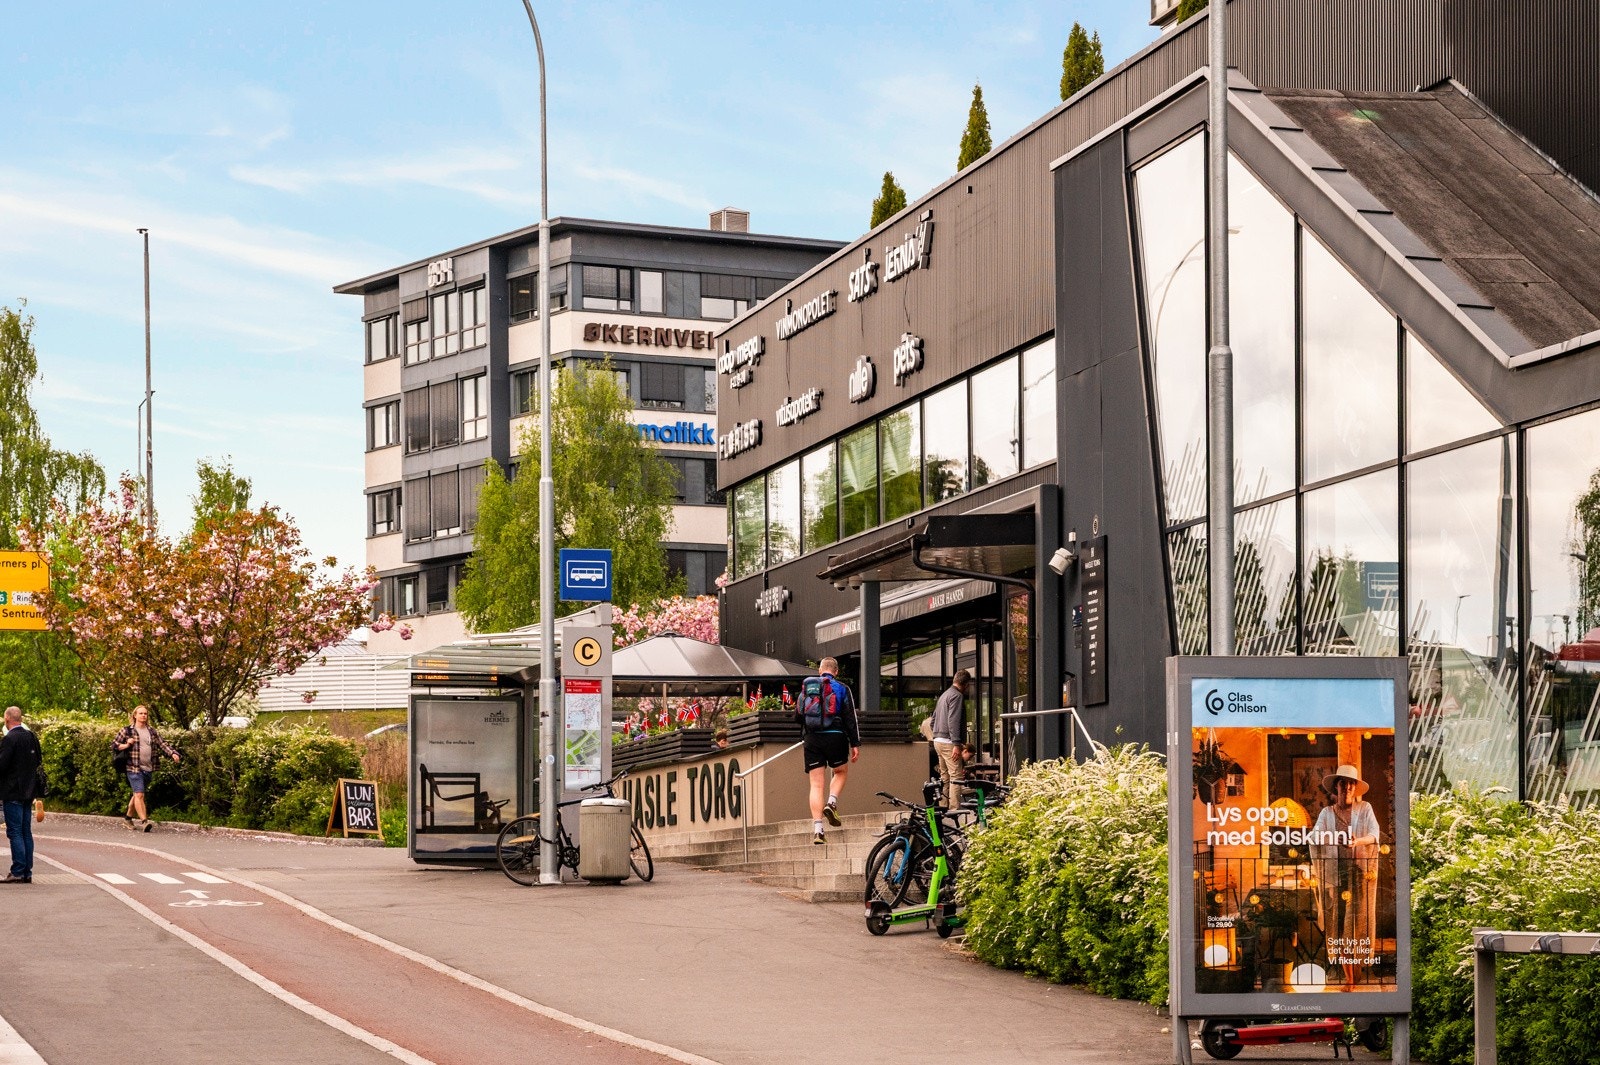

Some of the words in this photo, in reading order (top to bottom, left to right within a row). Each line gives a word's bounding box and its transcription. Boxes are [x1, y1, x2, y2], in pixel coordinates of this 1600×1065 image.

[848, 262, 873, 302] SATS
[776, 290, 834, 340] VINMONOPOLET
[584, 322, 714, 350] ØKERNVEI
[627, 421, 715, 446] matikk
[31, 560, 43, 570] pl.
[581, 643, 594, 660] C
[1228, 692, 1253, 702] Clas
[1228, 703, 1267, 713] Ohlson
[346, 786, 372, 801] LUN
[687, 758, 741, 823] TORG
[347, 806, 374, 827] BAR
[1207, 802, 1242, 826] Lys
[1246, 806, 1289, 827] opp
[1207, 827, 1256, 846] med
[1260, 826, 1353, 846] solskinn!
[1327, 937, 1345, 946] Sett
[1346, 937, 1357, 948] lys
[1359, 936, 1371, 948] på
[1327, 946, 1342, 955] det
[1343, 946, 1355, 955] du
[1328, 956, 1337, 965] Vi
[1338, 956, 1362, 965] fikser
[1363, 956, 1381, 965] det!
